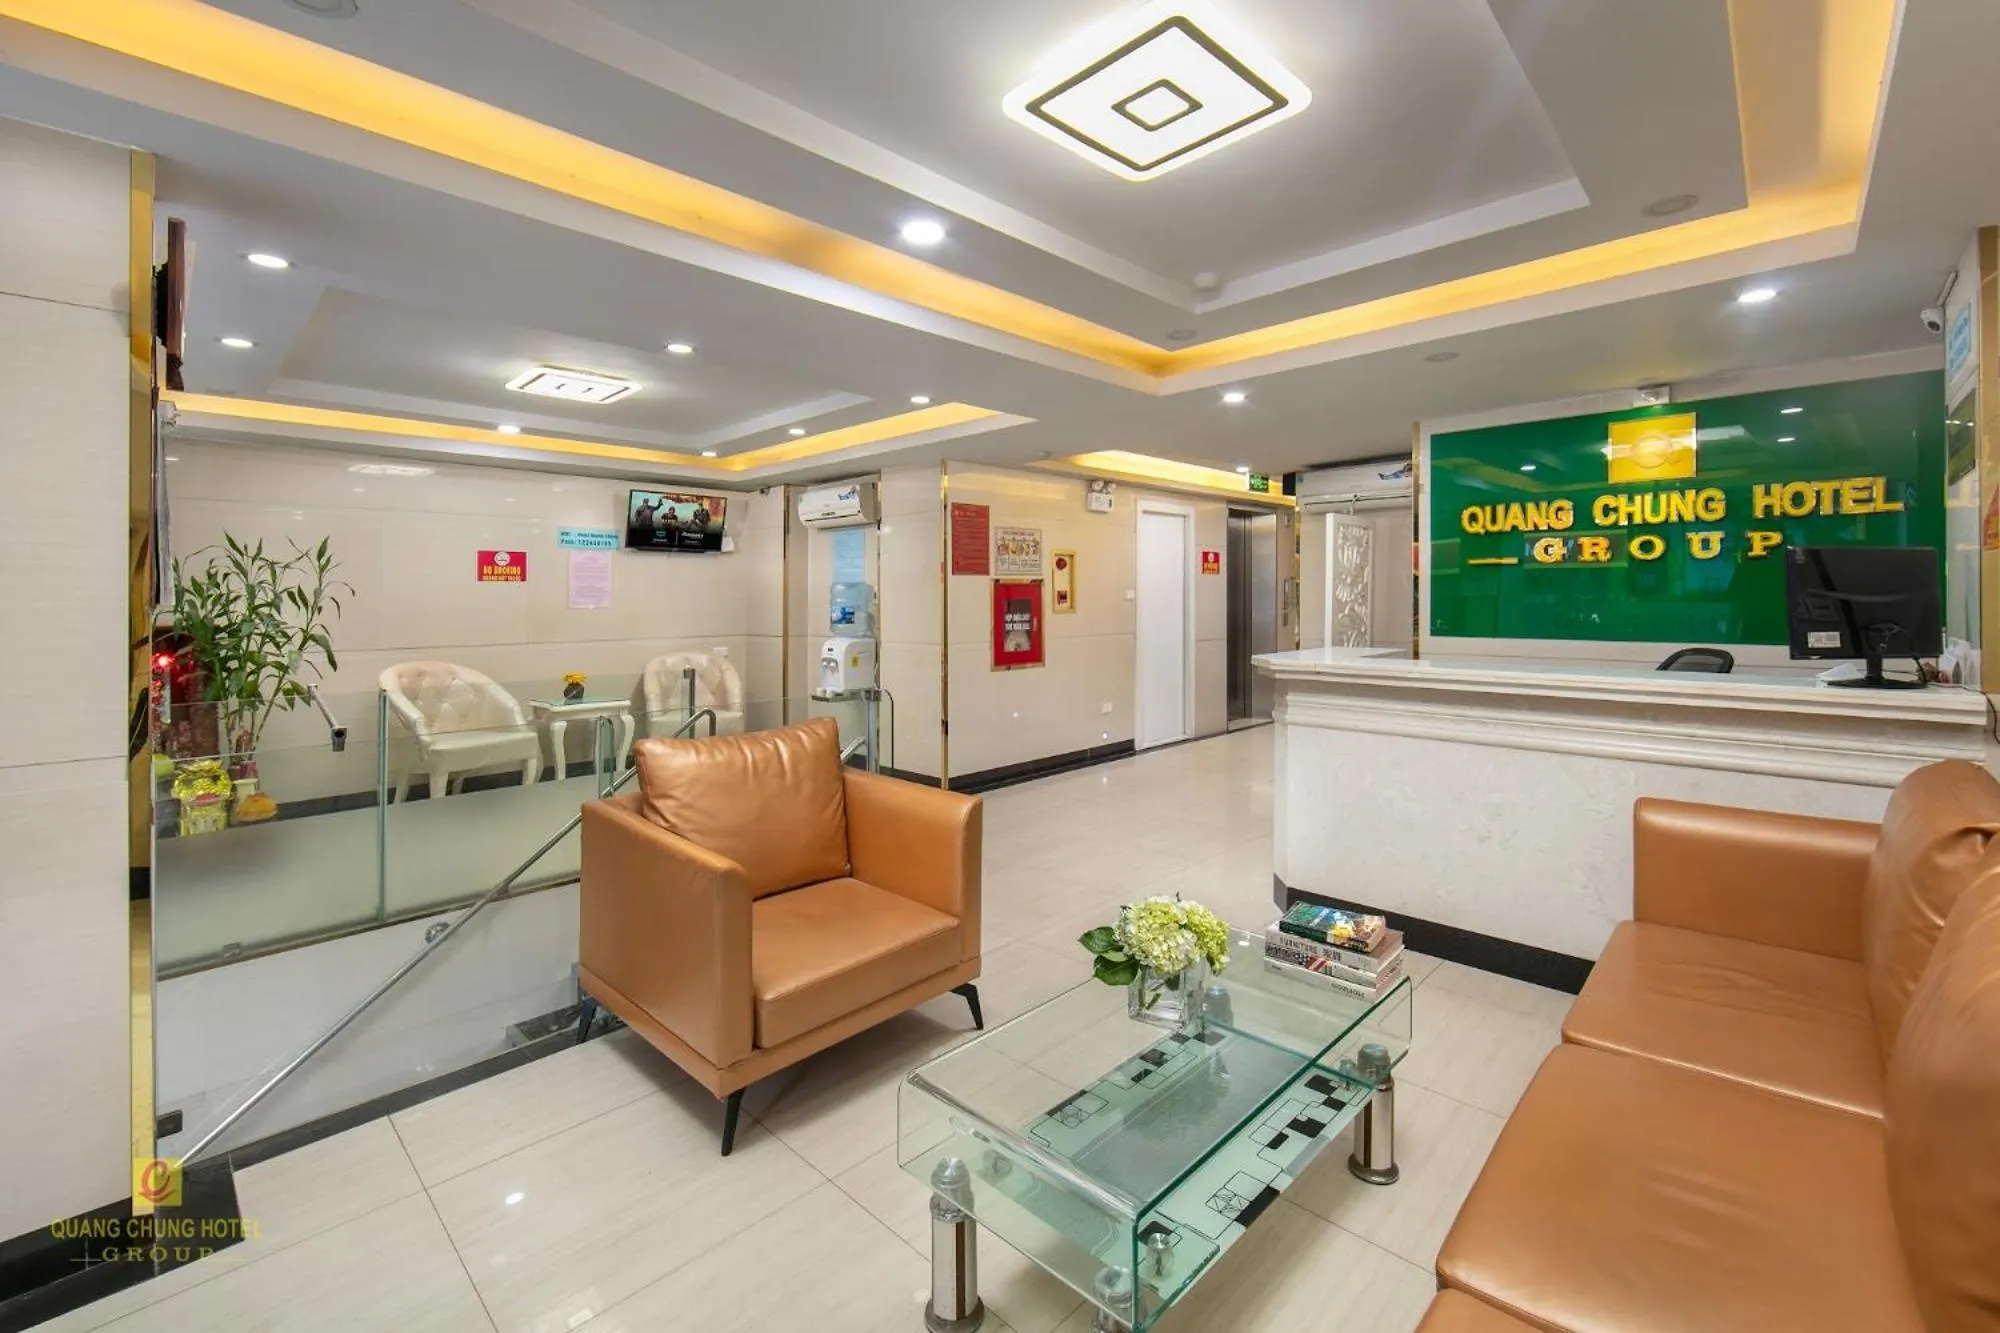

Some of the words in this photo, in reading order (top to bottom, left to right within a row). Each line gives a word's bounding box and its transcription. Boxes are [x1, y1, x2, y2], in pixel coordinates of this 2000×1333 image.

[1461, 499, 1574, 536] QUANG
[1592, 487, 1727, 527] CHUNG
[1752, 476, 1904, 519] HOTEL
[1533, 531, 1784, 564] GROUP
